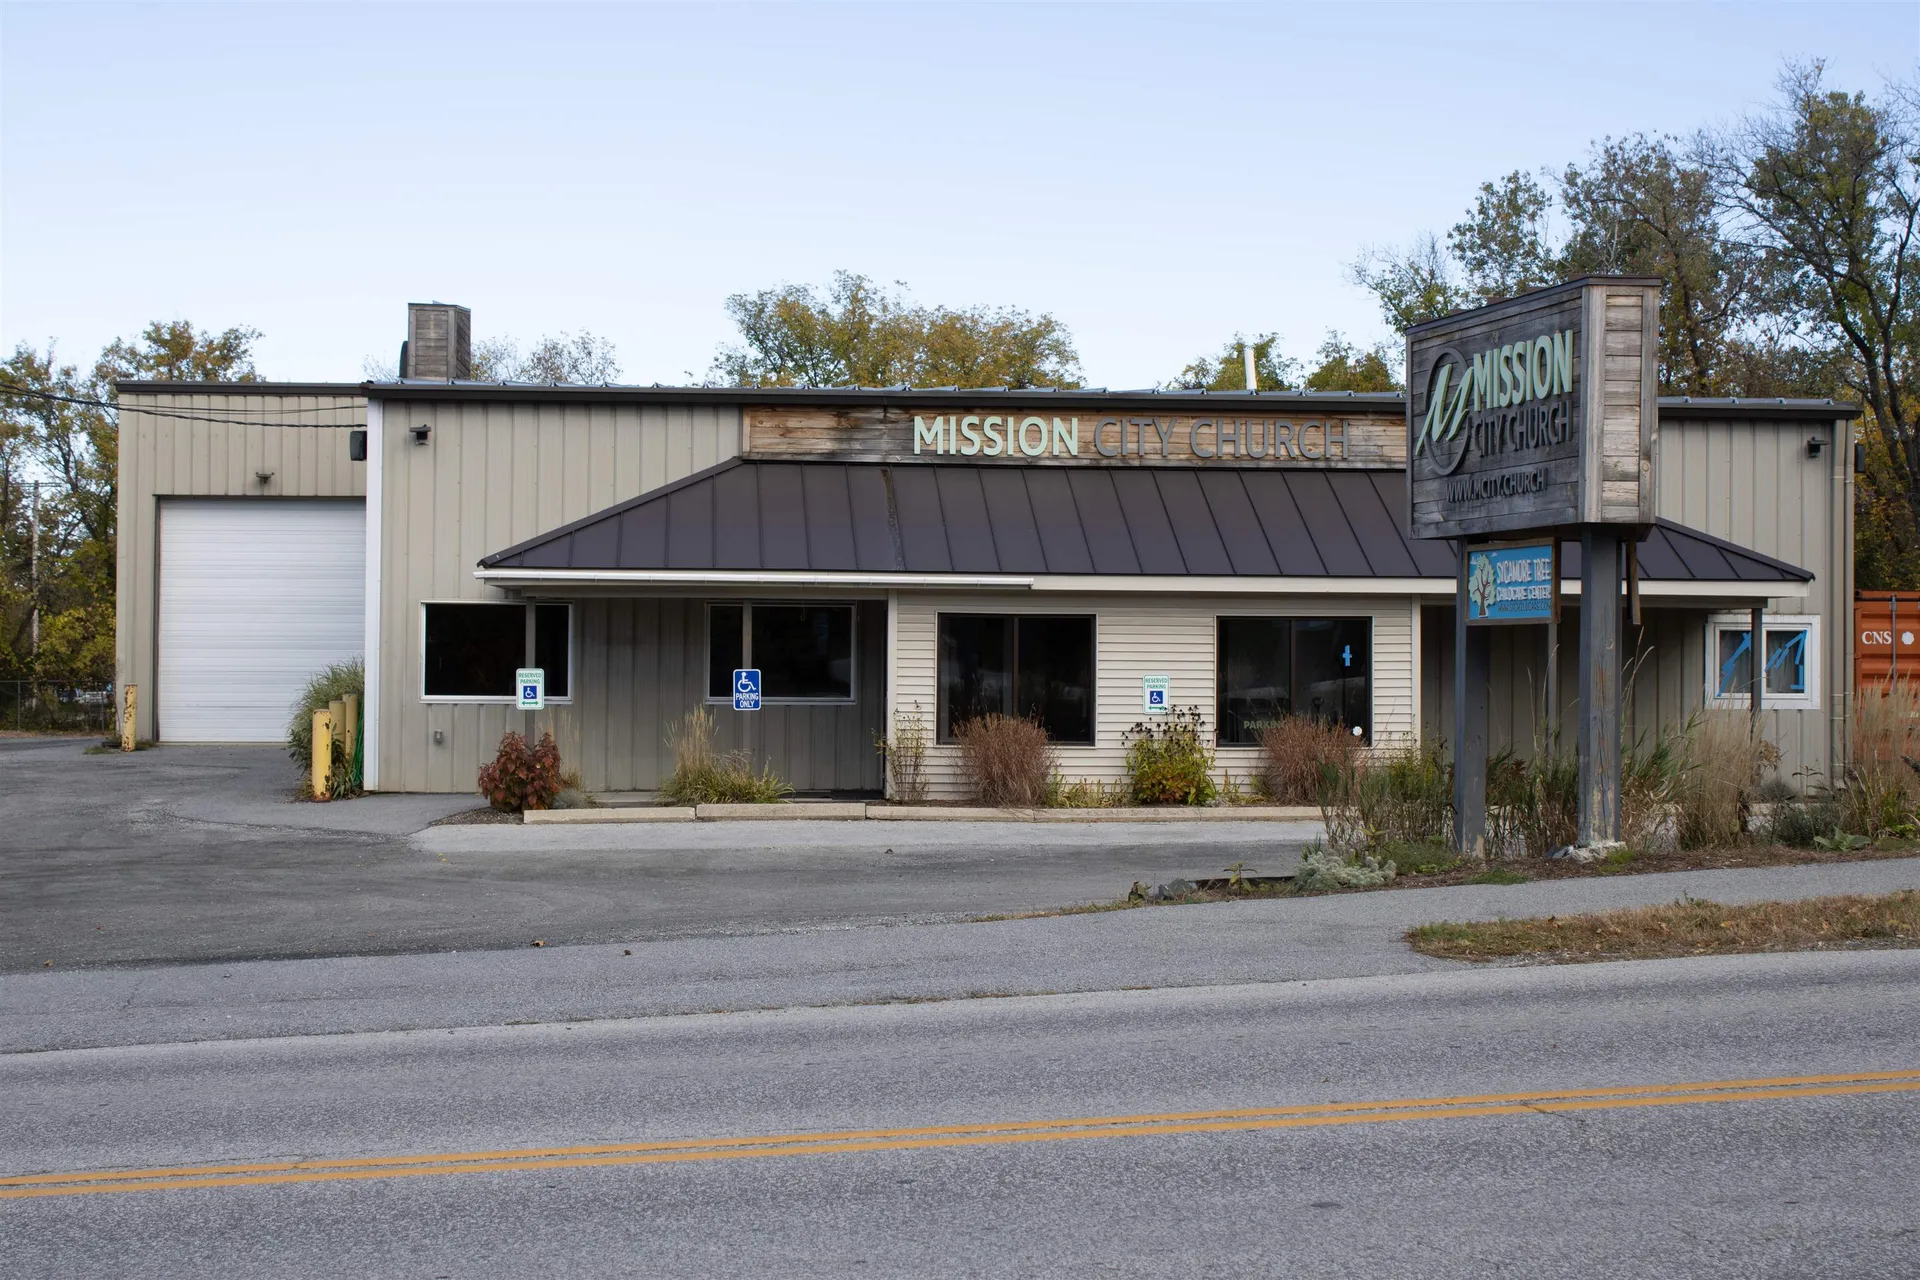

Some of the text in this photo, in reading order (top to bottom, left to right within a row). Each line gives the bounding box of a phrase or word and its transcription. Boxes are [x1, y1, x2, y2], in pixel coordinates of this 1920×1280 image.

[1473, 329, 1574, 412] MISSION
[913, 415, 1349, 459] MISSION CITY CHURCH
[1474, 400, 1574, 458] CITY CHURCH
[1446, 468, 1548, 503] WWW.MCITY.CHURCH
[1496, 558, 1552, 584] SYCAMORE TREE
[1496, 585, 1552, 602] CHILDCARE CENTER
[1861, 631, 1892, 645] CNS
[735, 692, 759, 701] PARKING
[739, 700, 755, 708] ONLY
